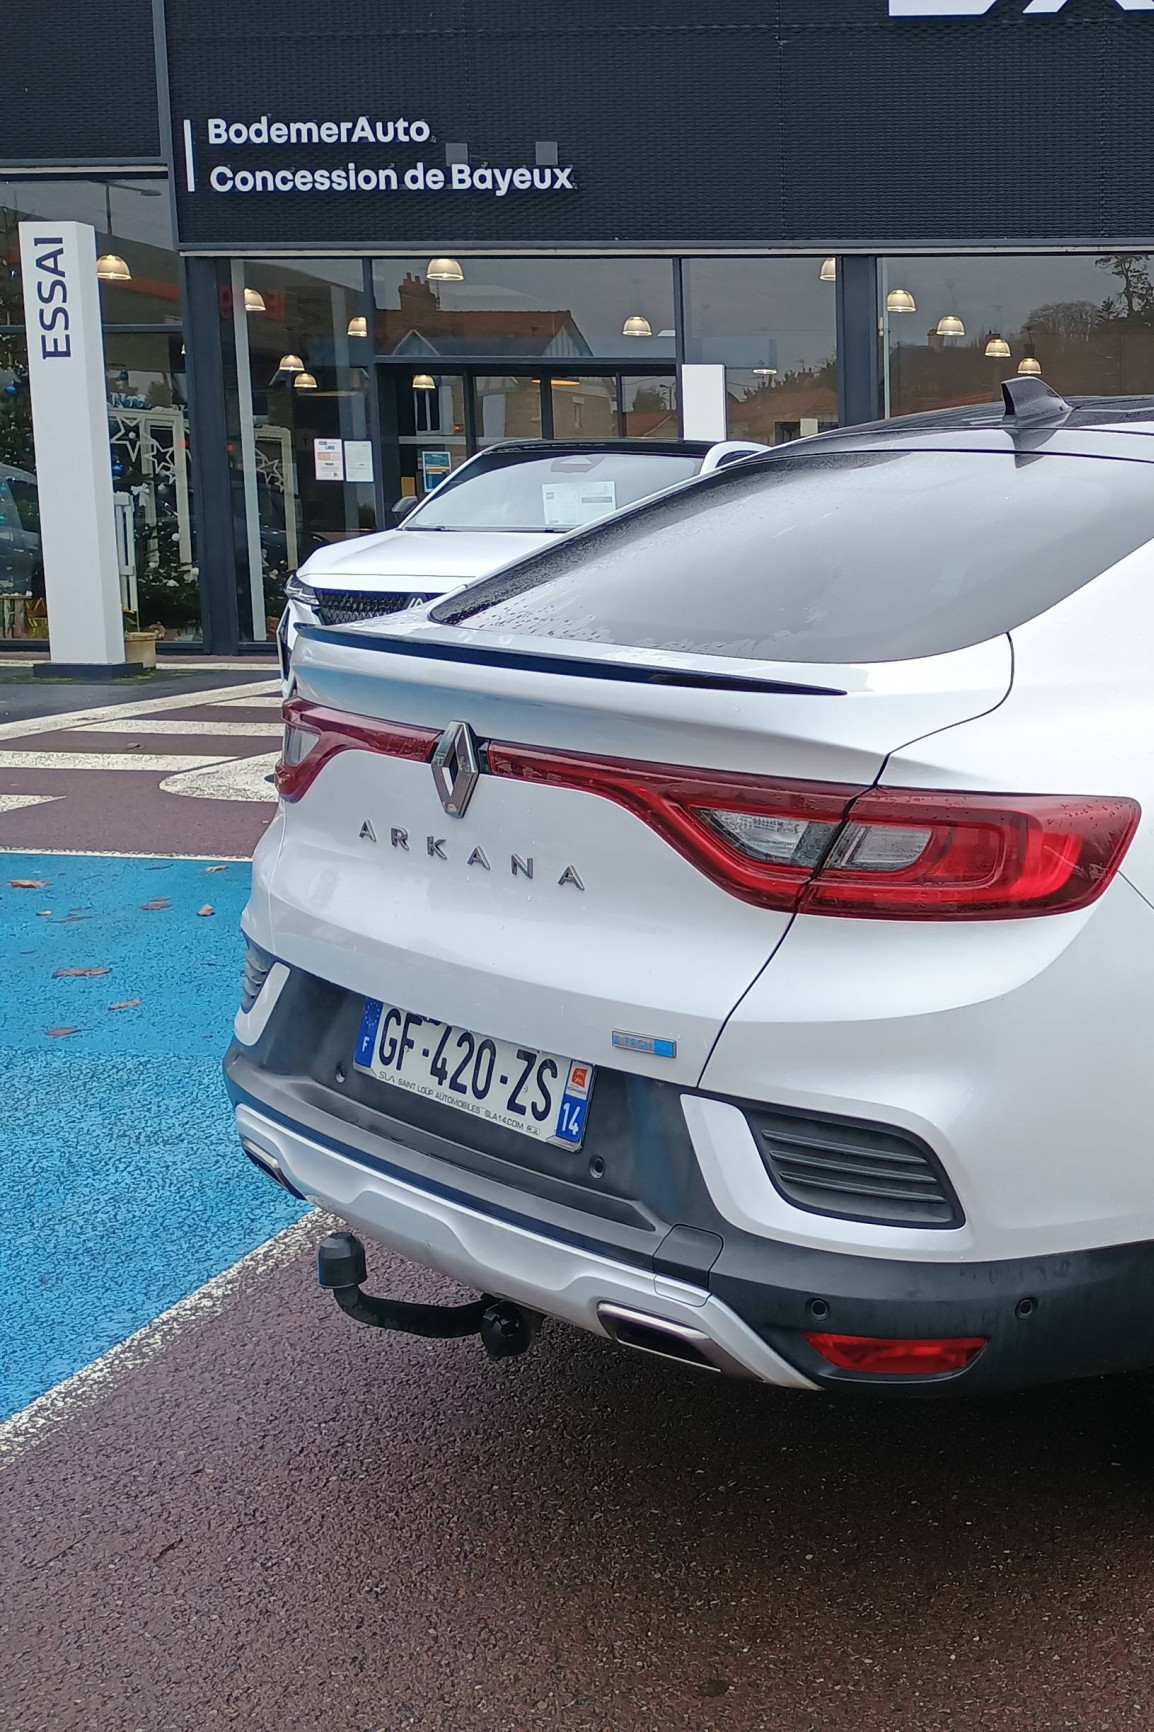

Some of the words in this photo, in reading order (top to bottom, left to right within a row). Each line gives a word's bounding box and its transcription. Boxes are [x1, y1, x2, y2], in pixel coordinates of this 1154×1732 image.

[207, 115, 431, 145] BodemerAuto
[209, 162, 398, 193] Concession
[404, 161, 445, 190] de
[451, 163, 574, 197] Bayeux
[33, 237, 72, 361] ESSAI
[358, 818, 586, 892] ARKANA
[361, 1036, 370, 1052] F
[378, 1007, 558, 1122] GF-420-ZS
[398, 1078, 417, 1091] SAINT
[417, 1085, 434, 1096] LOUP
[435, 1092, 481, 1115] AUTOMOBILES
[561, 1102, 581, 1136] 14
